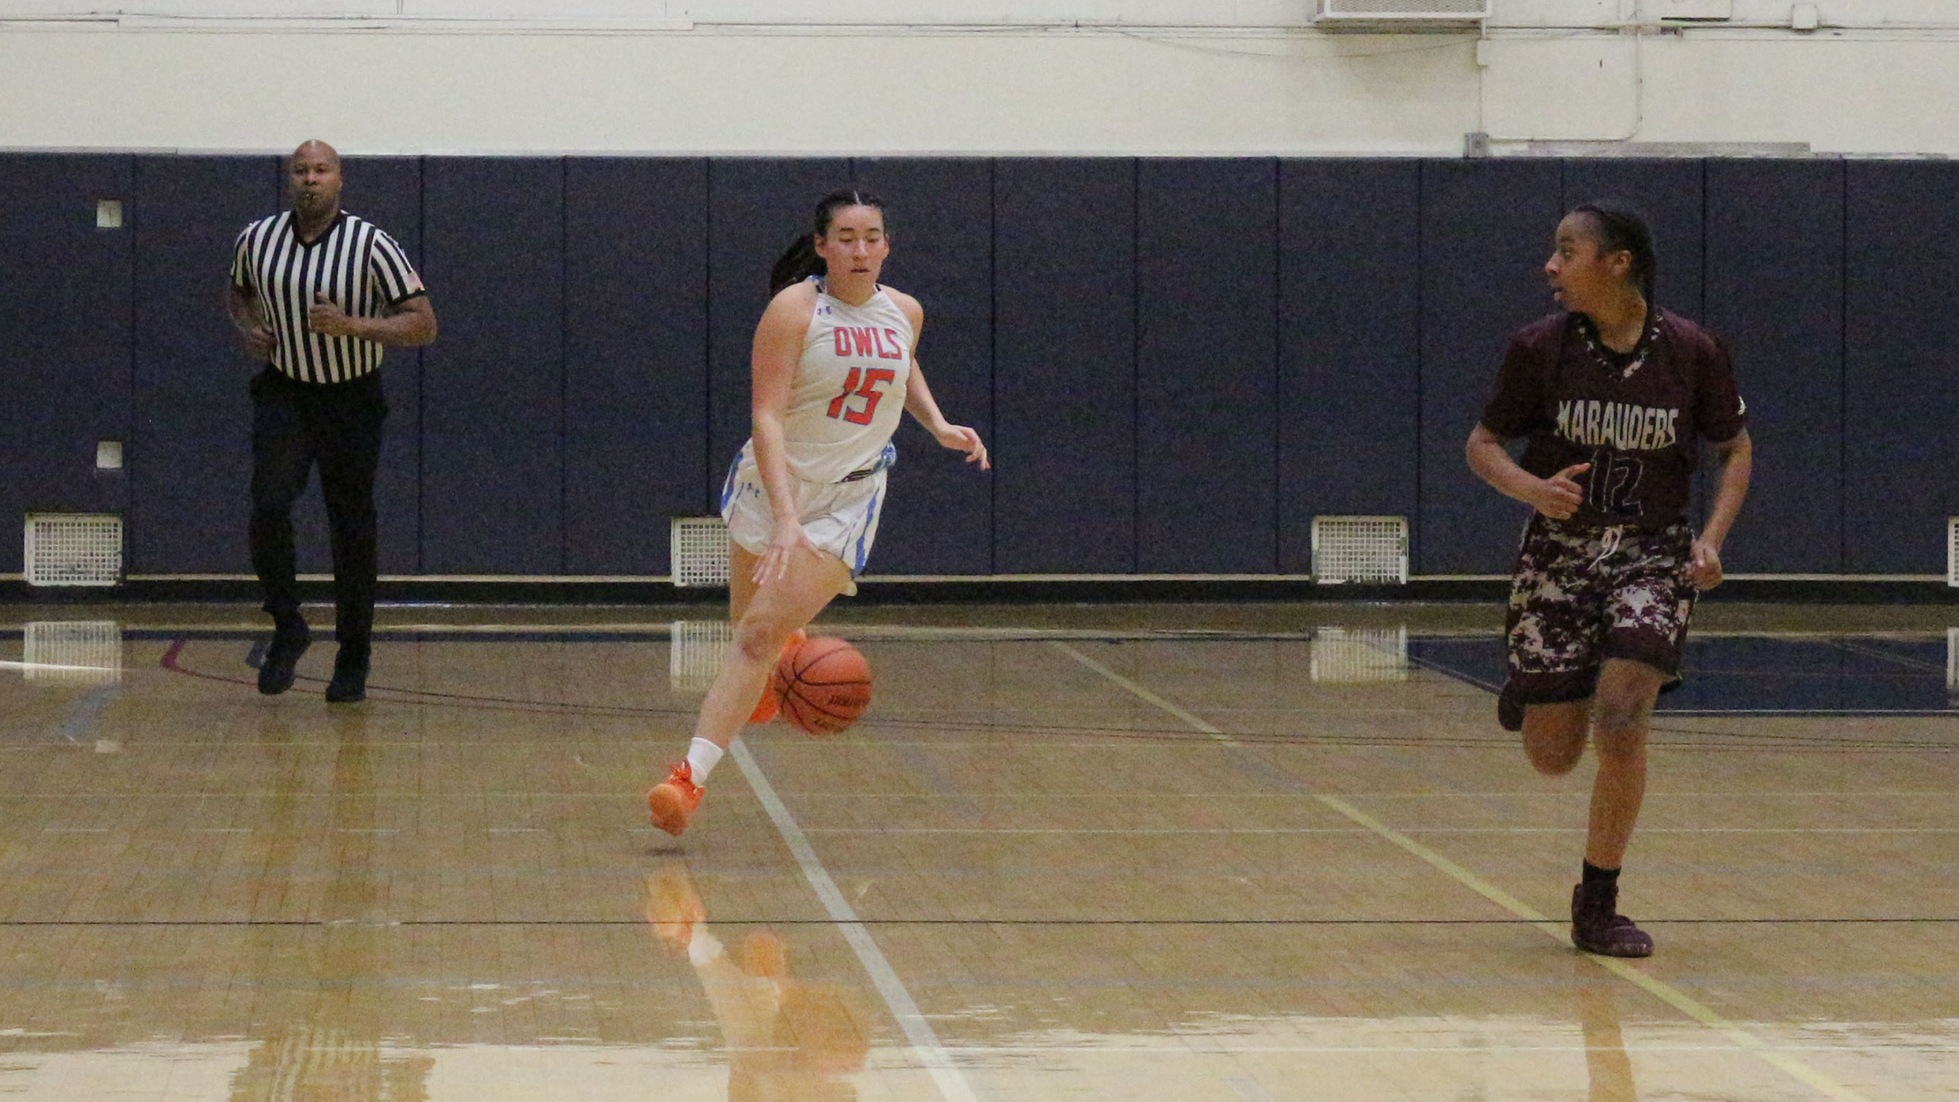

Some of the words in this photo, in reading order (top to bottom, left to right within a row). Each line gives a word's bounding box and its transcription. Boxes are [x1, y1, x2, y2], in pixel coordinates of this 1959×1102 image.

[834, 326, 902, 360] OWLS
[826, 366, 896, 426] 15
[1554, 399, 1679, 450] MARAUDERS
[1589, 450, 1644, 516] 12
